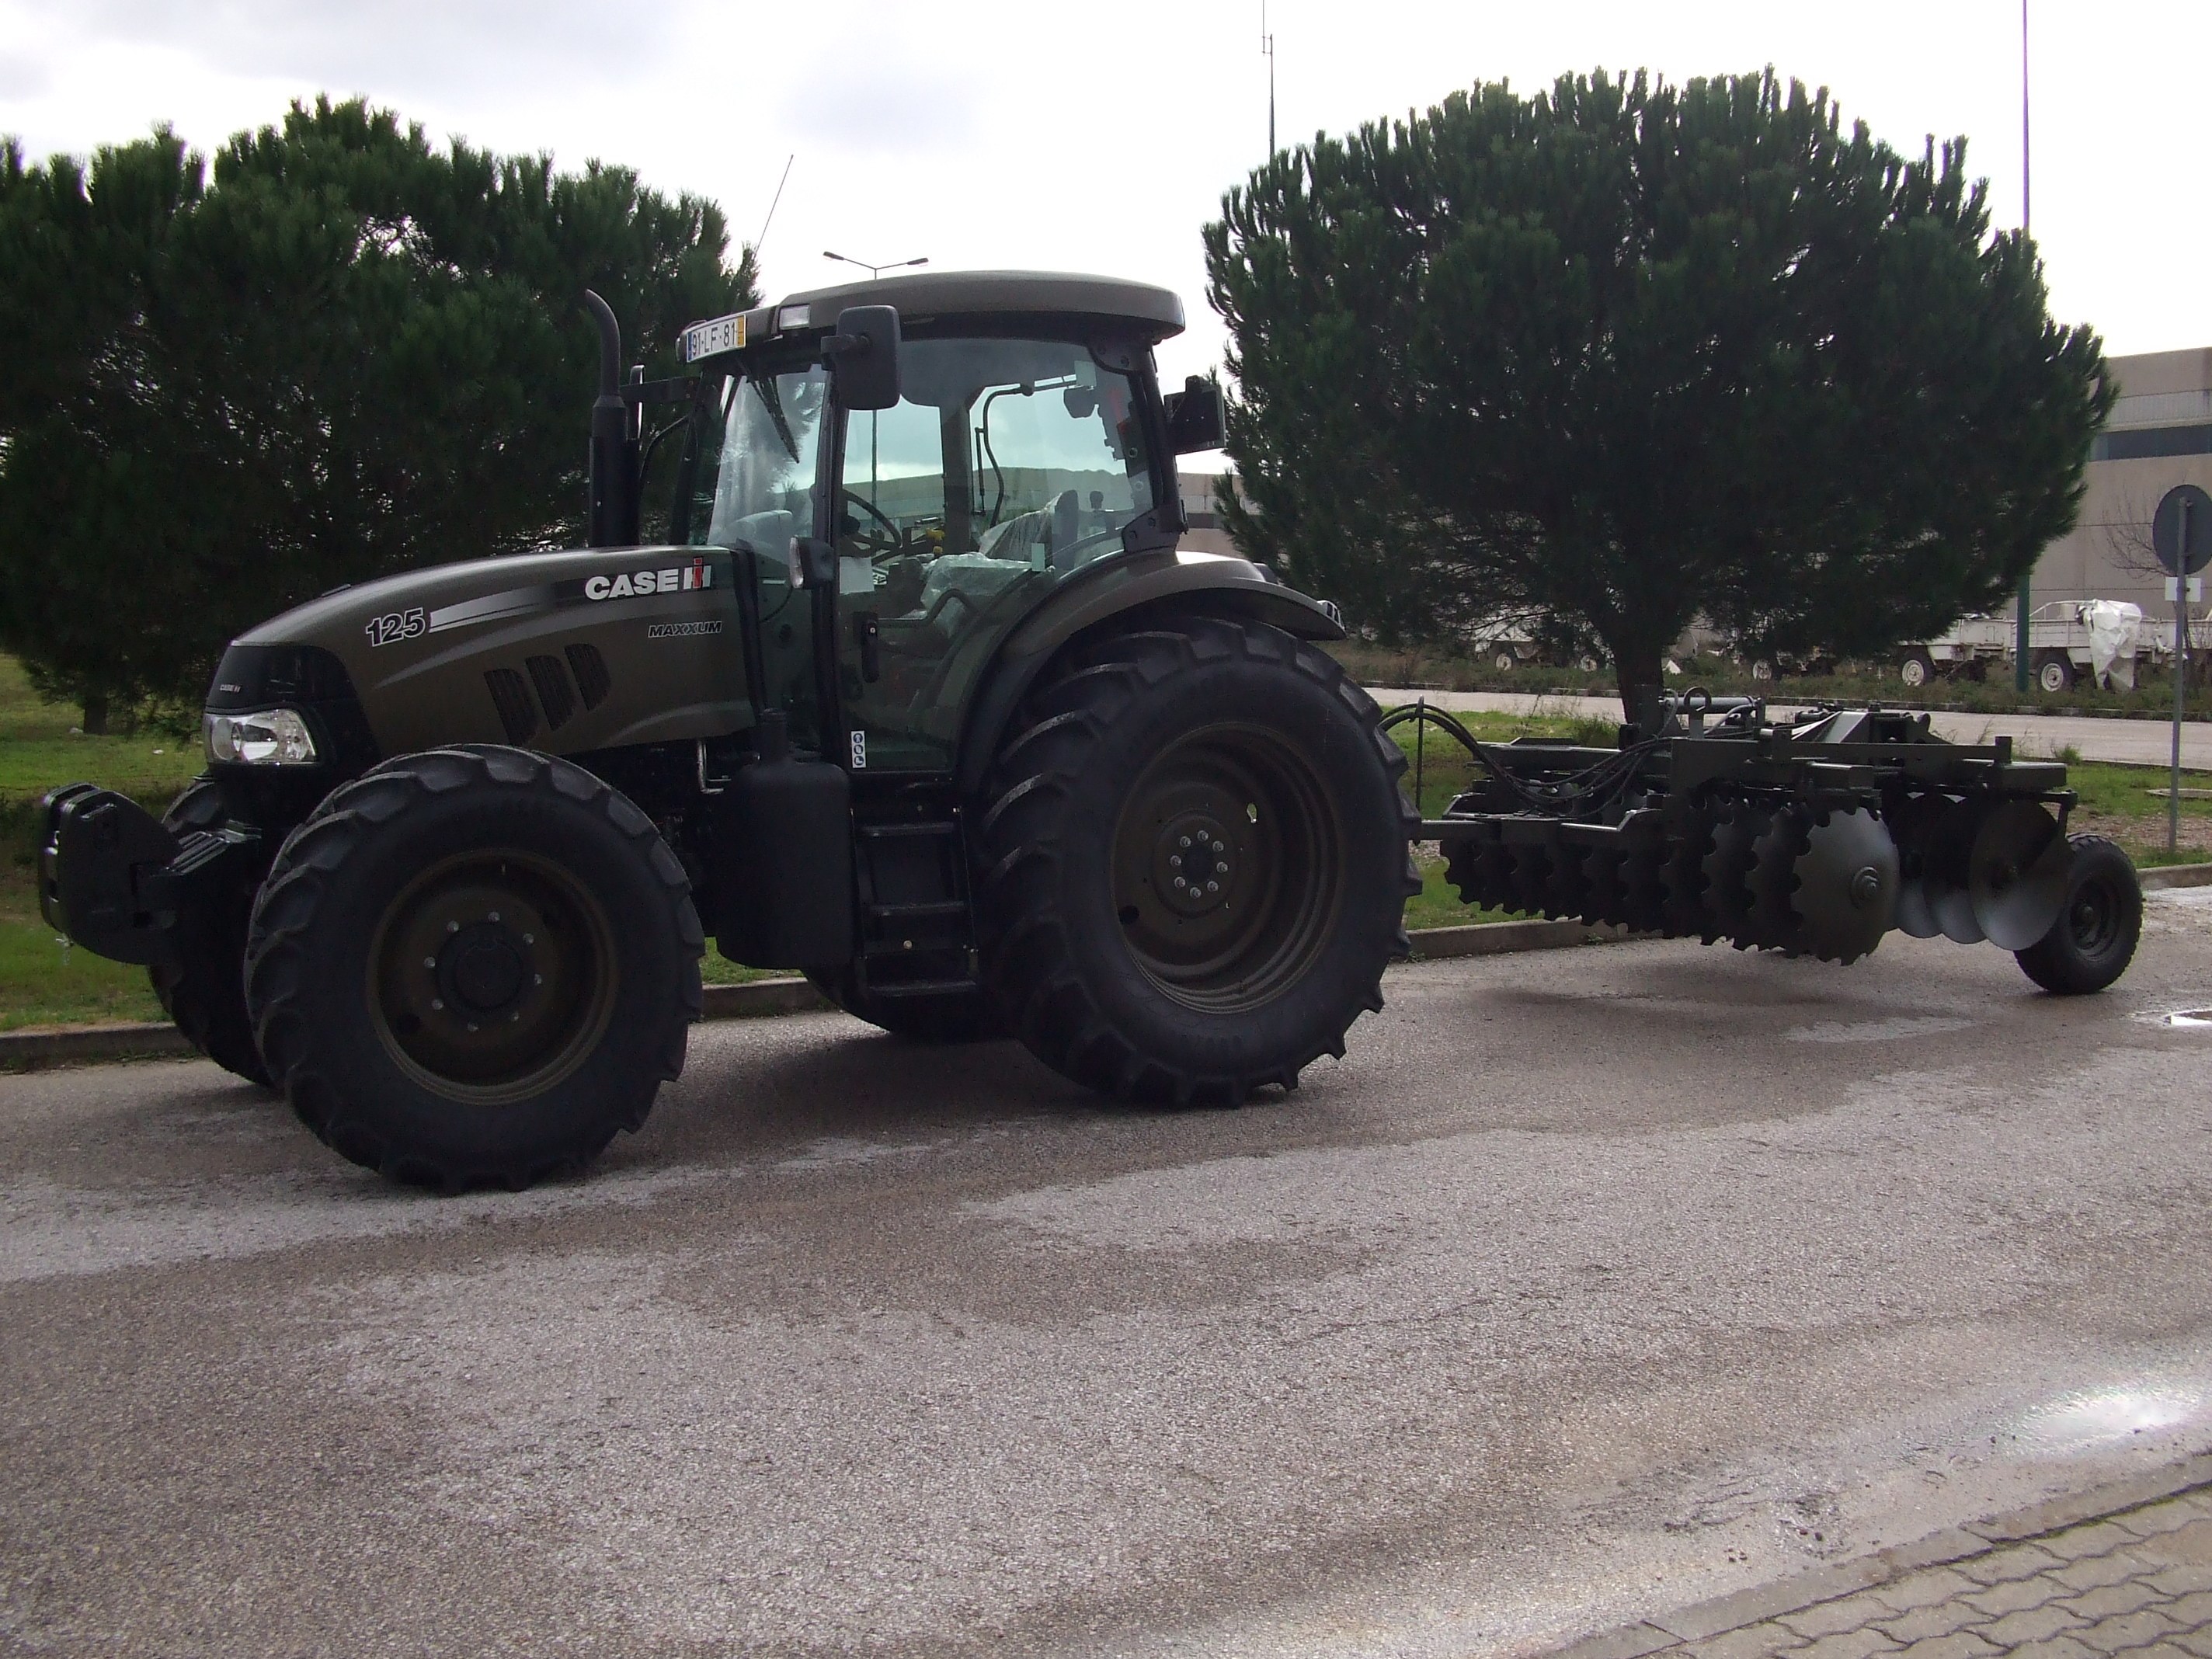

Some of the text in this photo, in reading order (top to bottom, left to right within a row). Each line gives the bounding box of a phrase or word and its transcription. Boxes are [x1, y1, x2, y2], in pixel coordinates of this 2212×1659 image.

[692, 322, 736, 356] 91-LF-81
[585, 569, 679, 600] CASE
[365, 607, 425, 647] 125
[647, 621, 722, 639] MAXXUM
